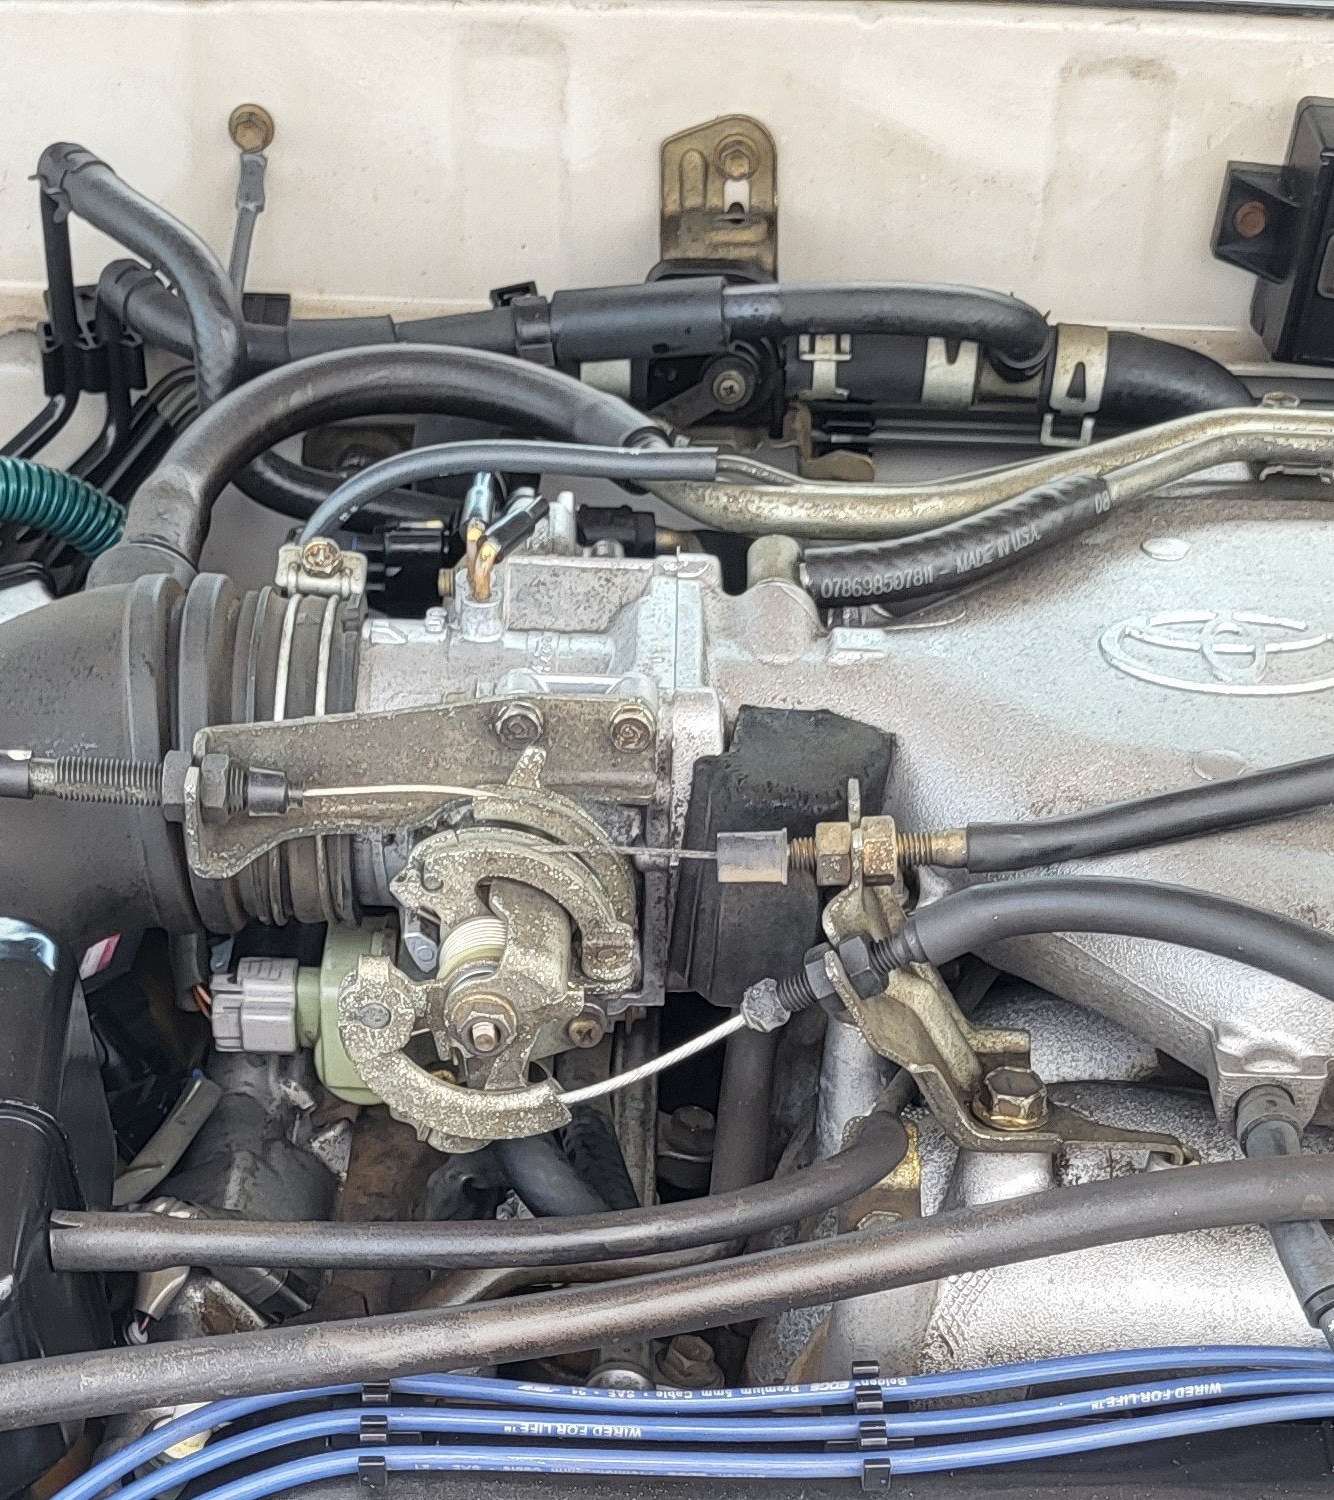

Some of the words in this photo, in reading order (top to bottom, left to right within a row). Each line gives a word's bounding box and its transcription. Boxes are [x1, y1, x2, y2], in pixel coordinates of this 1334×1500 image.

[955, 546, 996, 575] MADE
[996, 537, 1011, 560] IN
[607, 1389, 636, 1400] SAE
[655, 1389, 694, 1401] Cable
[740, 1384, 801, 1397] Premium
[1140, 1389, 1173, 1404] FOR
[1175, 1382, 1223, 1399] WIRED
[556, 1423, 589, 1437] FOR
[592, 1424, 643, 1439] WIRED
